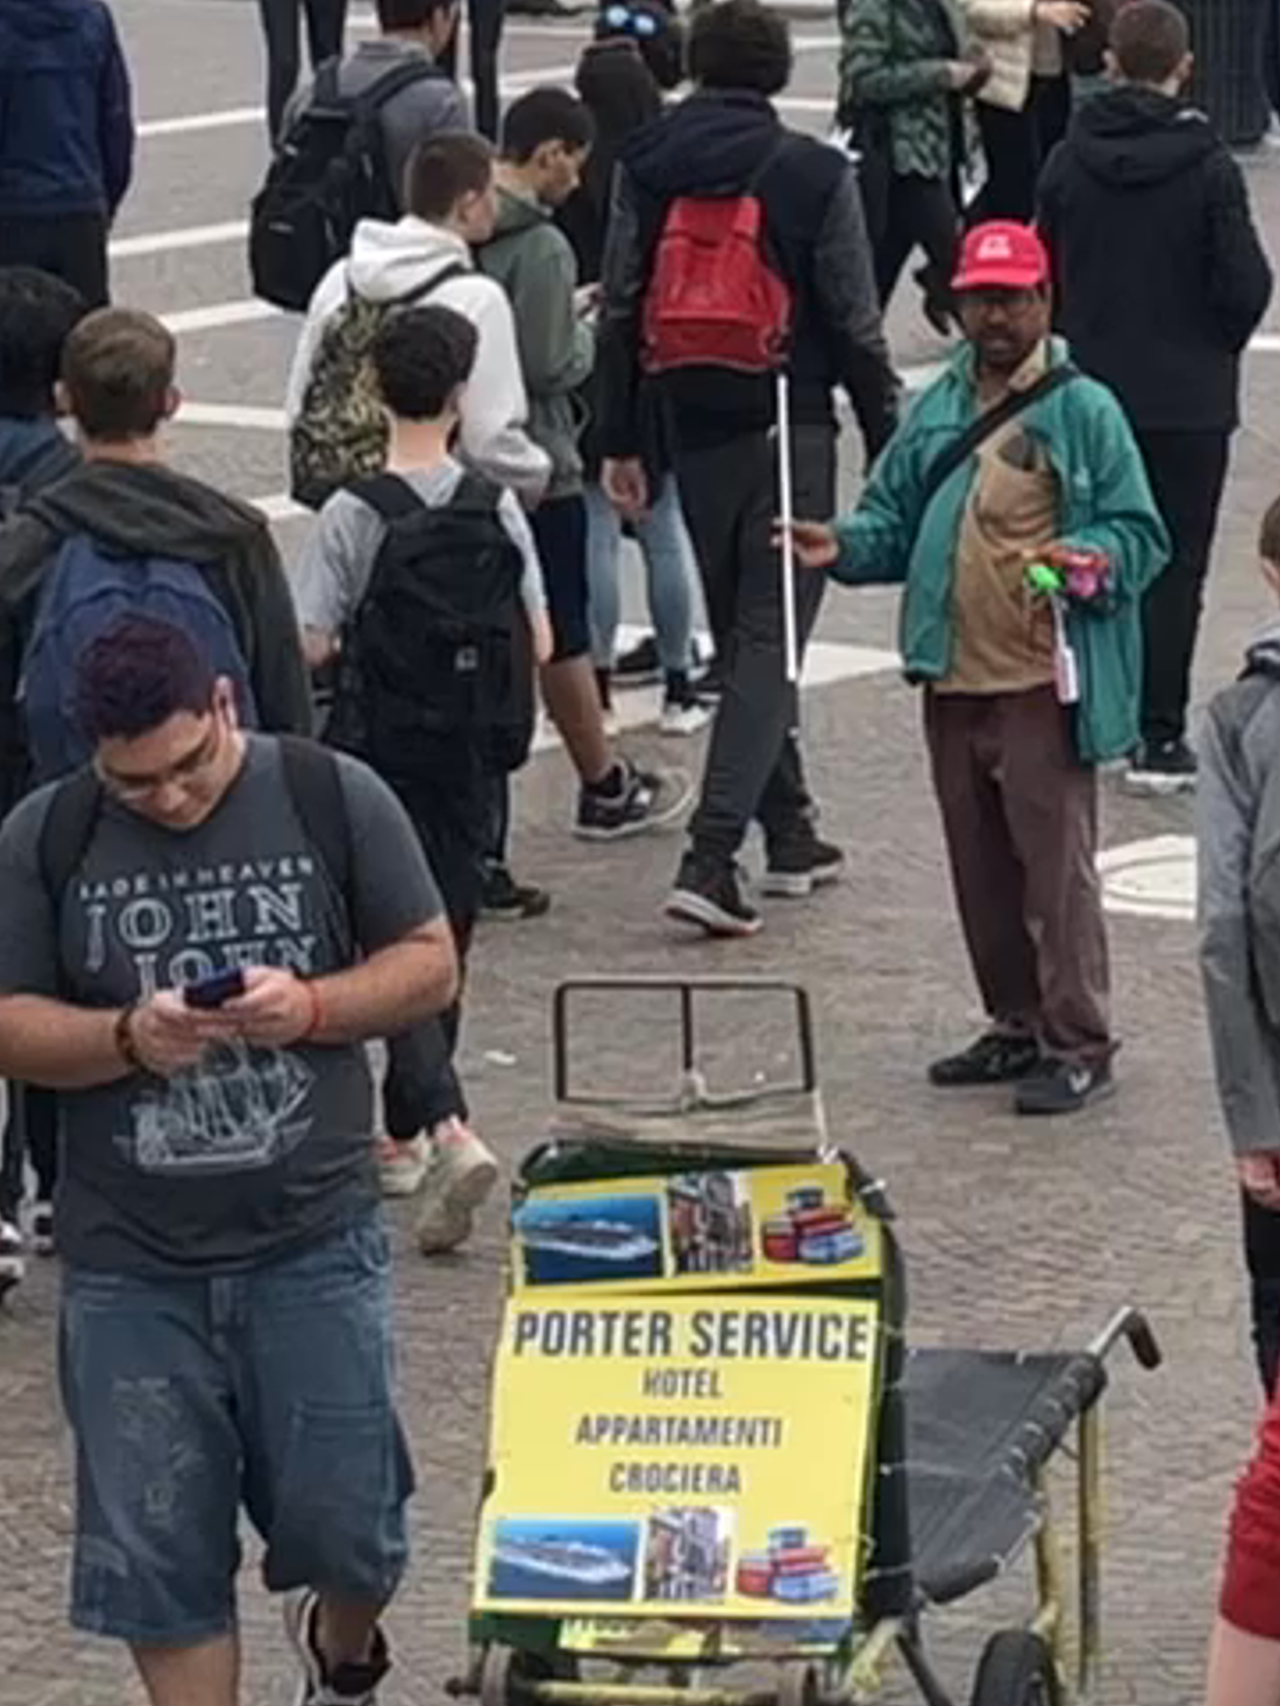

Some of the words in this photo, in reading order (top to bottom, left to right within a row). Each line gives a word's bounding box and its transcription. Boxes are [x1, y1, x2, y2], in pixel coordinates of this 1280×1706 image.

[195, 856, 313, 885] HEAVEN
[85, 882, 303, 974] JOHN
[513, 1310, 673, 1358] PORTER
[689, 1310, 869, 1362] SERVICE
[642, 1368, 723, 1398] HOTEL
[575, 1414, 783, 1448] APPARTAMENTI
[609, 1462, 742, 1495] CROCIERA
